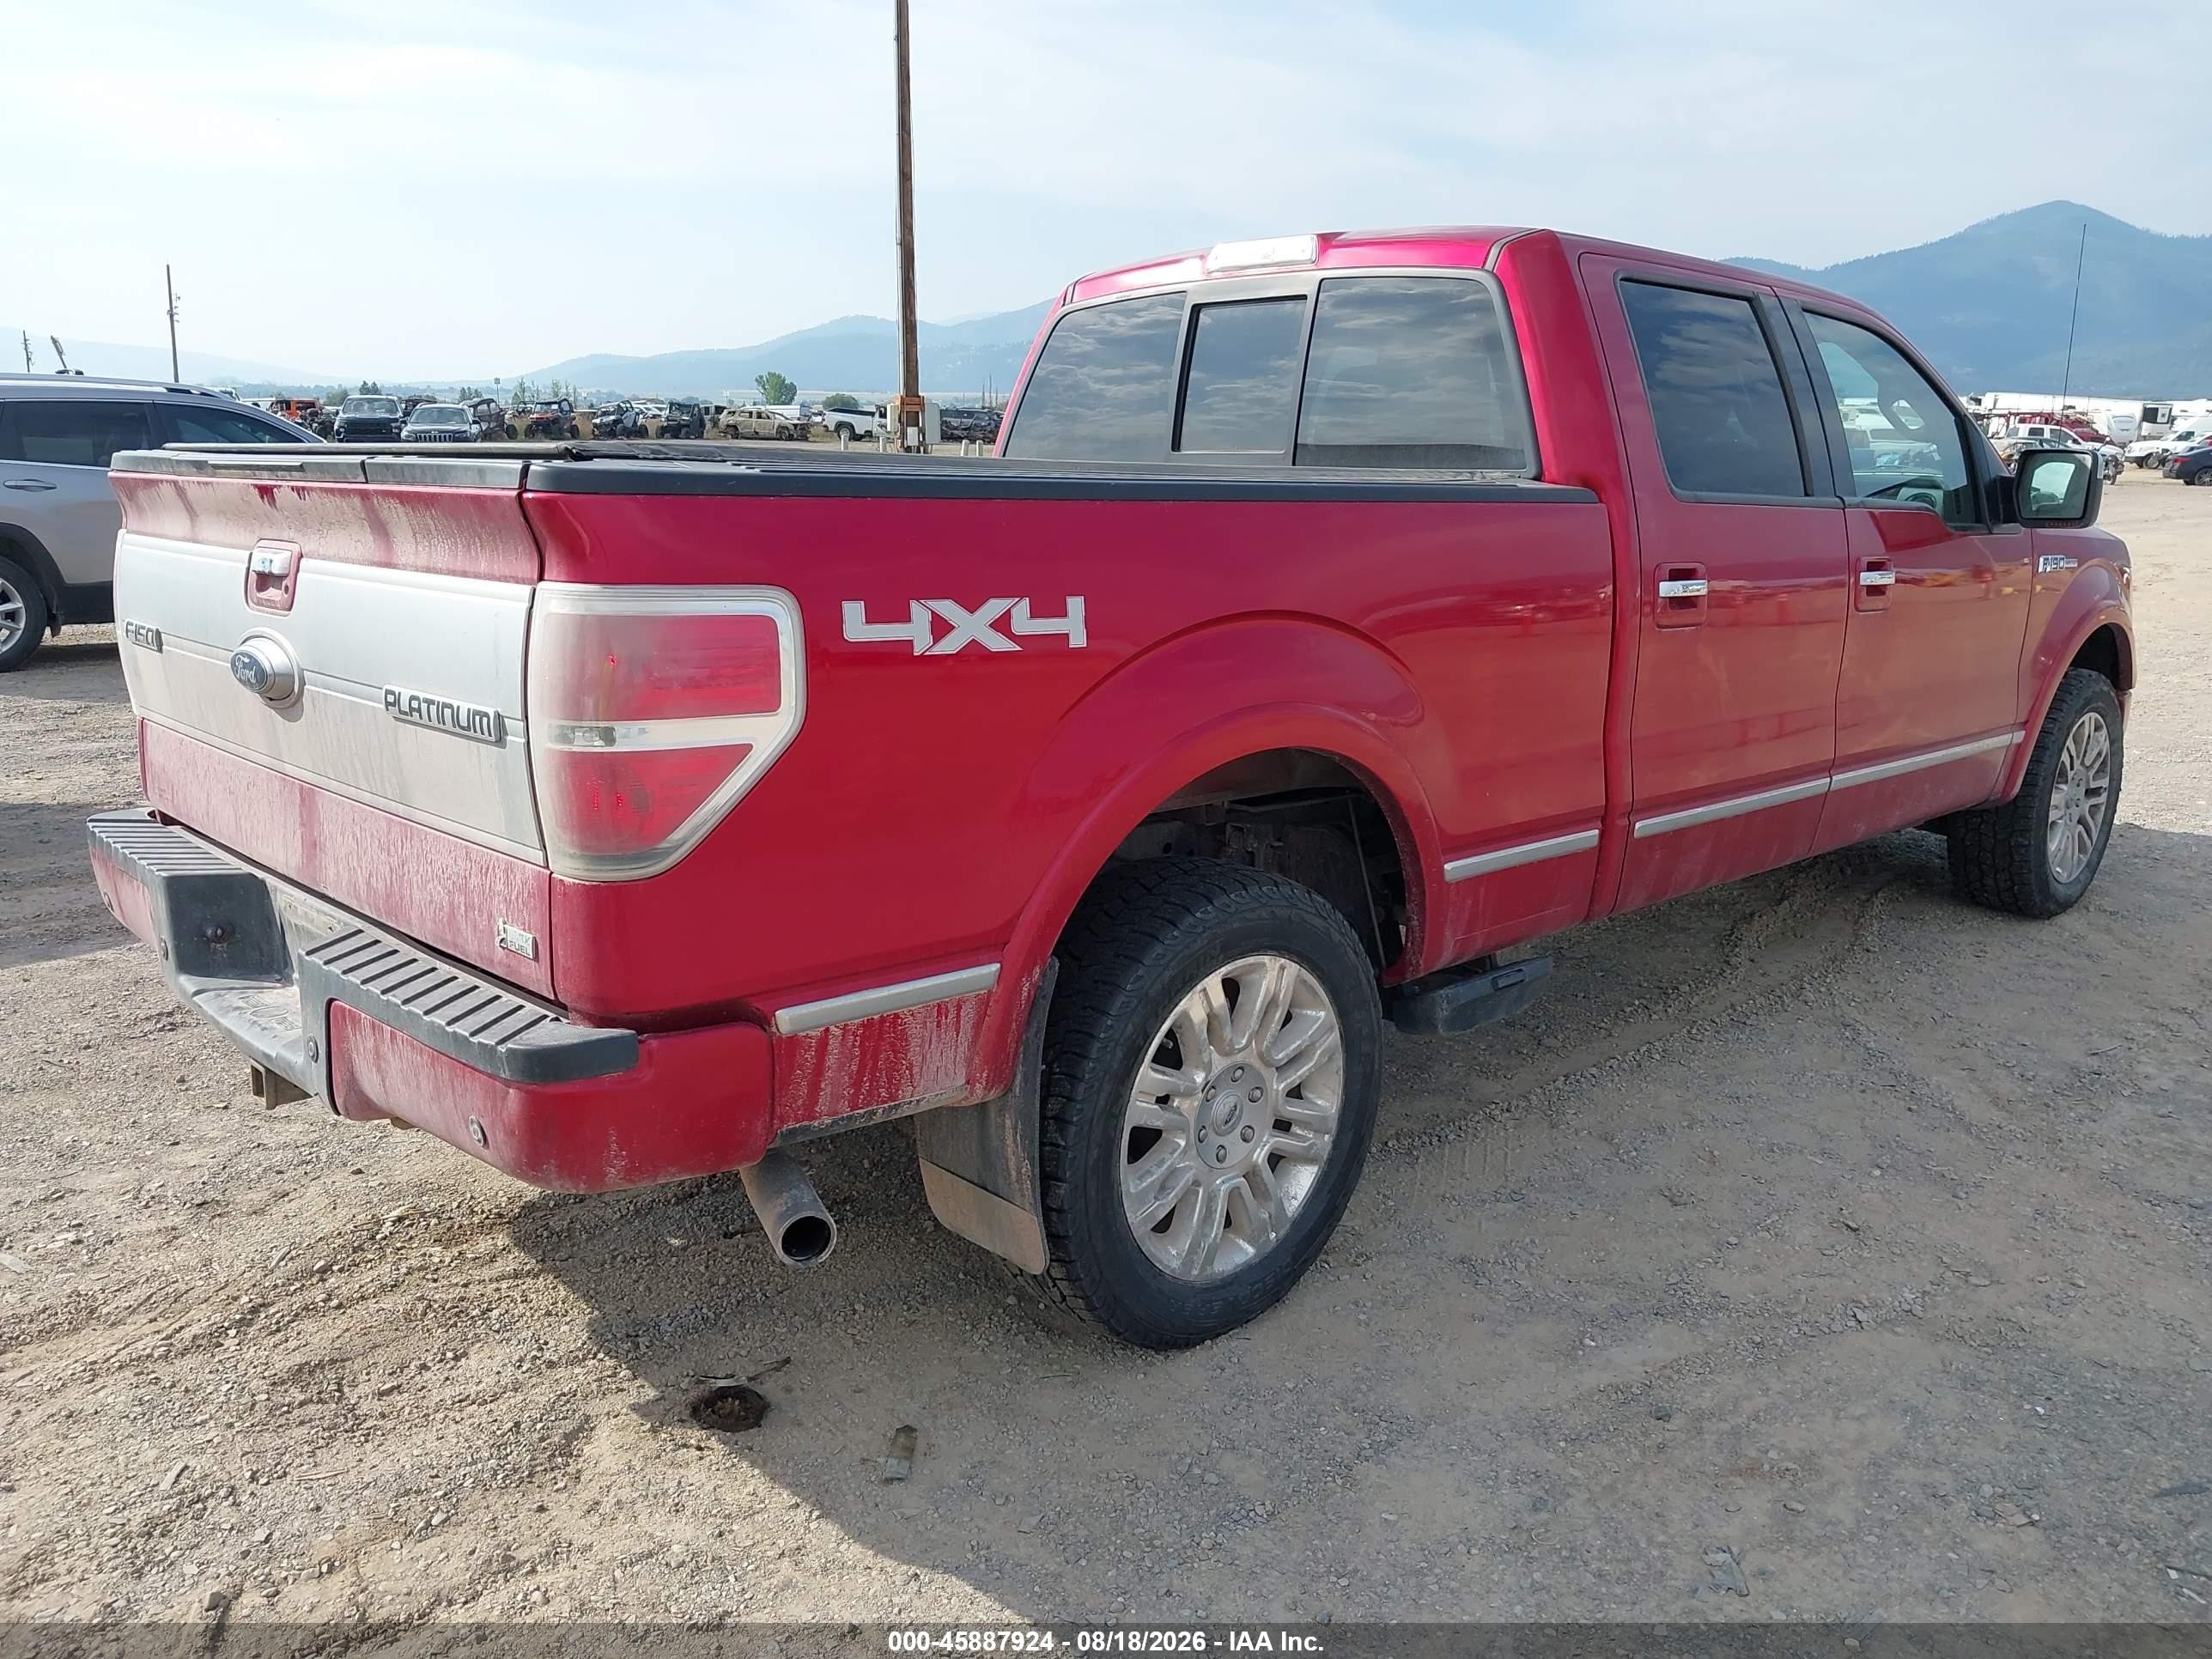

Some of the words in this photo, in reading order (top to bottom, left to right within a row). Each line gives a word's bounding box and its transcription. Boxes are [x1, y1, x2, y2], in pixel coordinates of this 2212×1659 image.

[842, 596, 1087, 656] 4X4
[234, 655, 257, 684] Ford
[385, 689, 493, 737] PLATINUM
